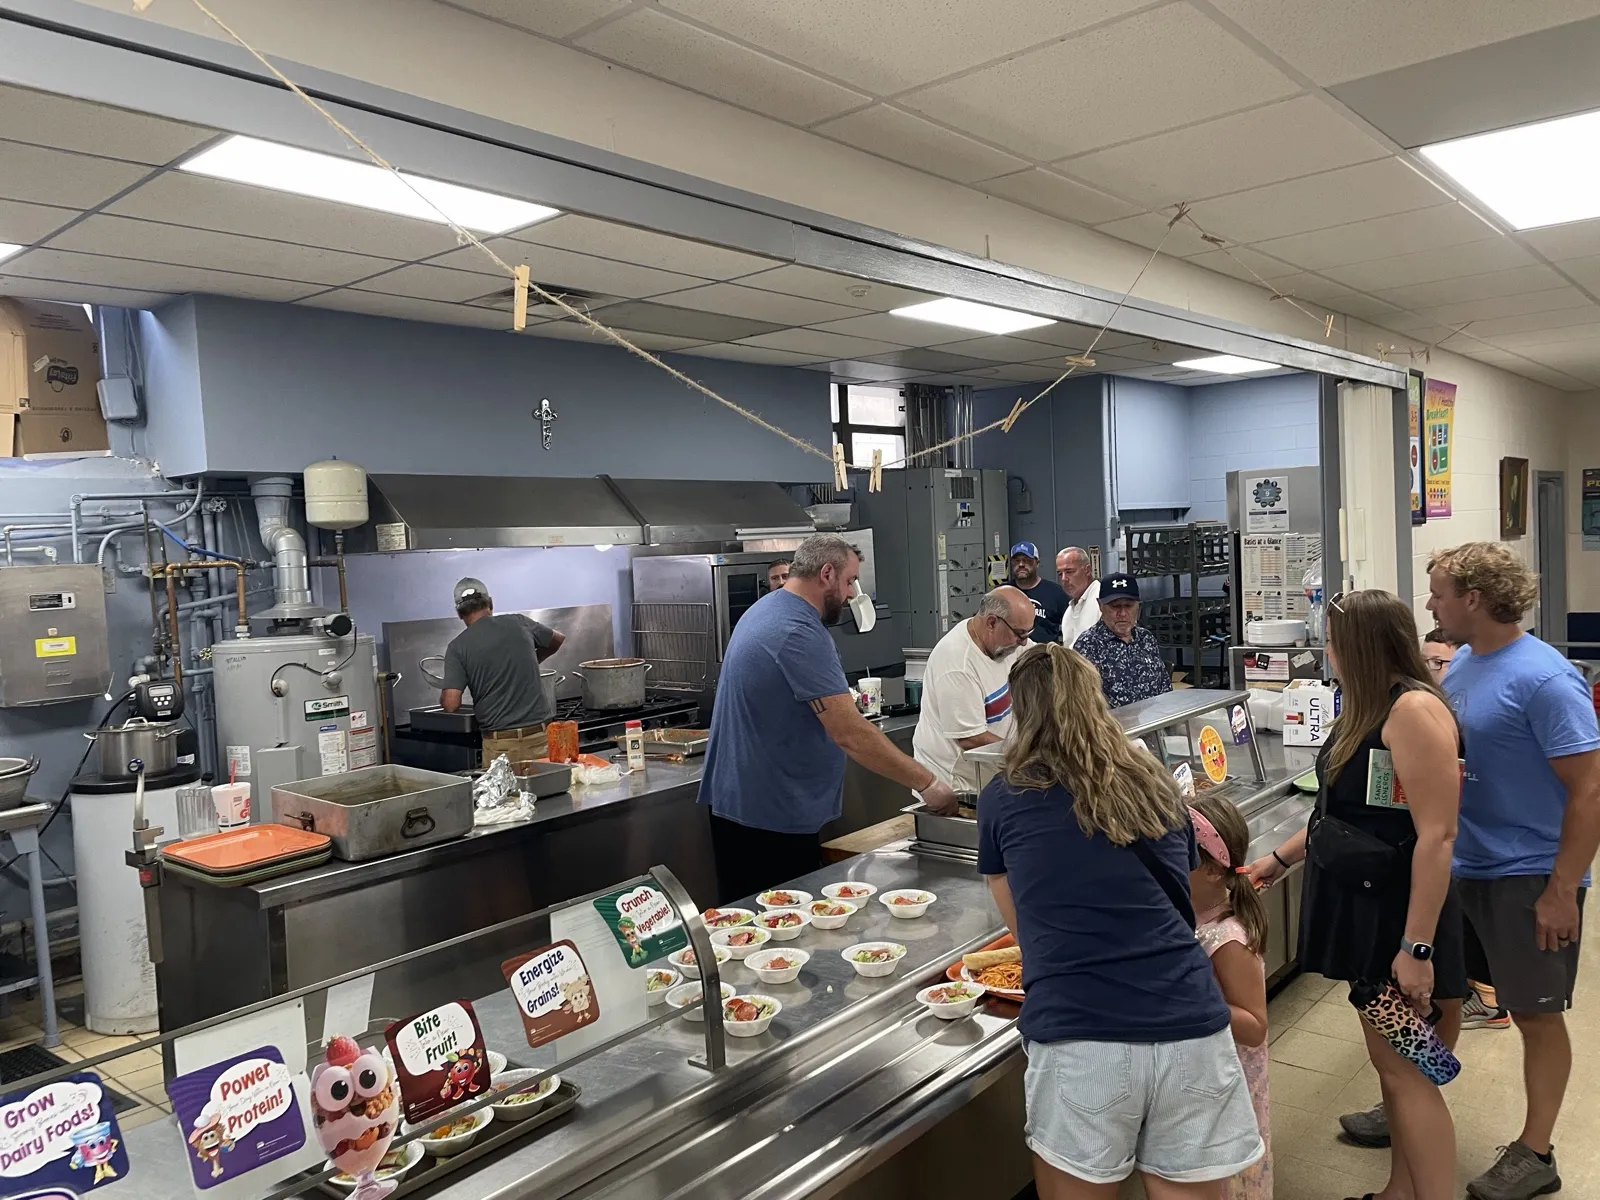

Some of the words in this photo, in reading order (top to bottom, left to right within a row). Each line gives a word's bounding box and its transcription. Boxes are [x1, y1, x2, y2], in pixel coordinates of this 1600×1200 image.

[322, 700, 344, 709] Smith
[1309, 697, 1320, 742] ULTRA
[1374, 775, 1382, 801] SANDRA
[1381, 772, 1390, 805] CISNEROS
[621, 889, 653, 913] Crunch
[636, 903, 671, 934] Vegetable!
[519, 950, 565, 986] Energize
[527, 982, 560, 1013] Grains!
[413, 1013, 441, 1039] Bite
[425, 1031, 458, 1065] Fruit!
[220, 1062, 271, 1101] Power
[4, 1092, 55, 1129] Grow
[227, 1088, 284, 1133] Protein!
[0, 1136, 45, 1171] Dairy
[45, 1103, 95, 1142] Foods!
